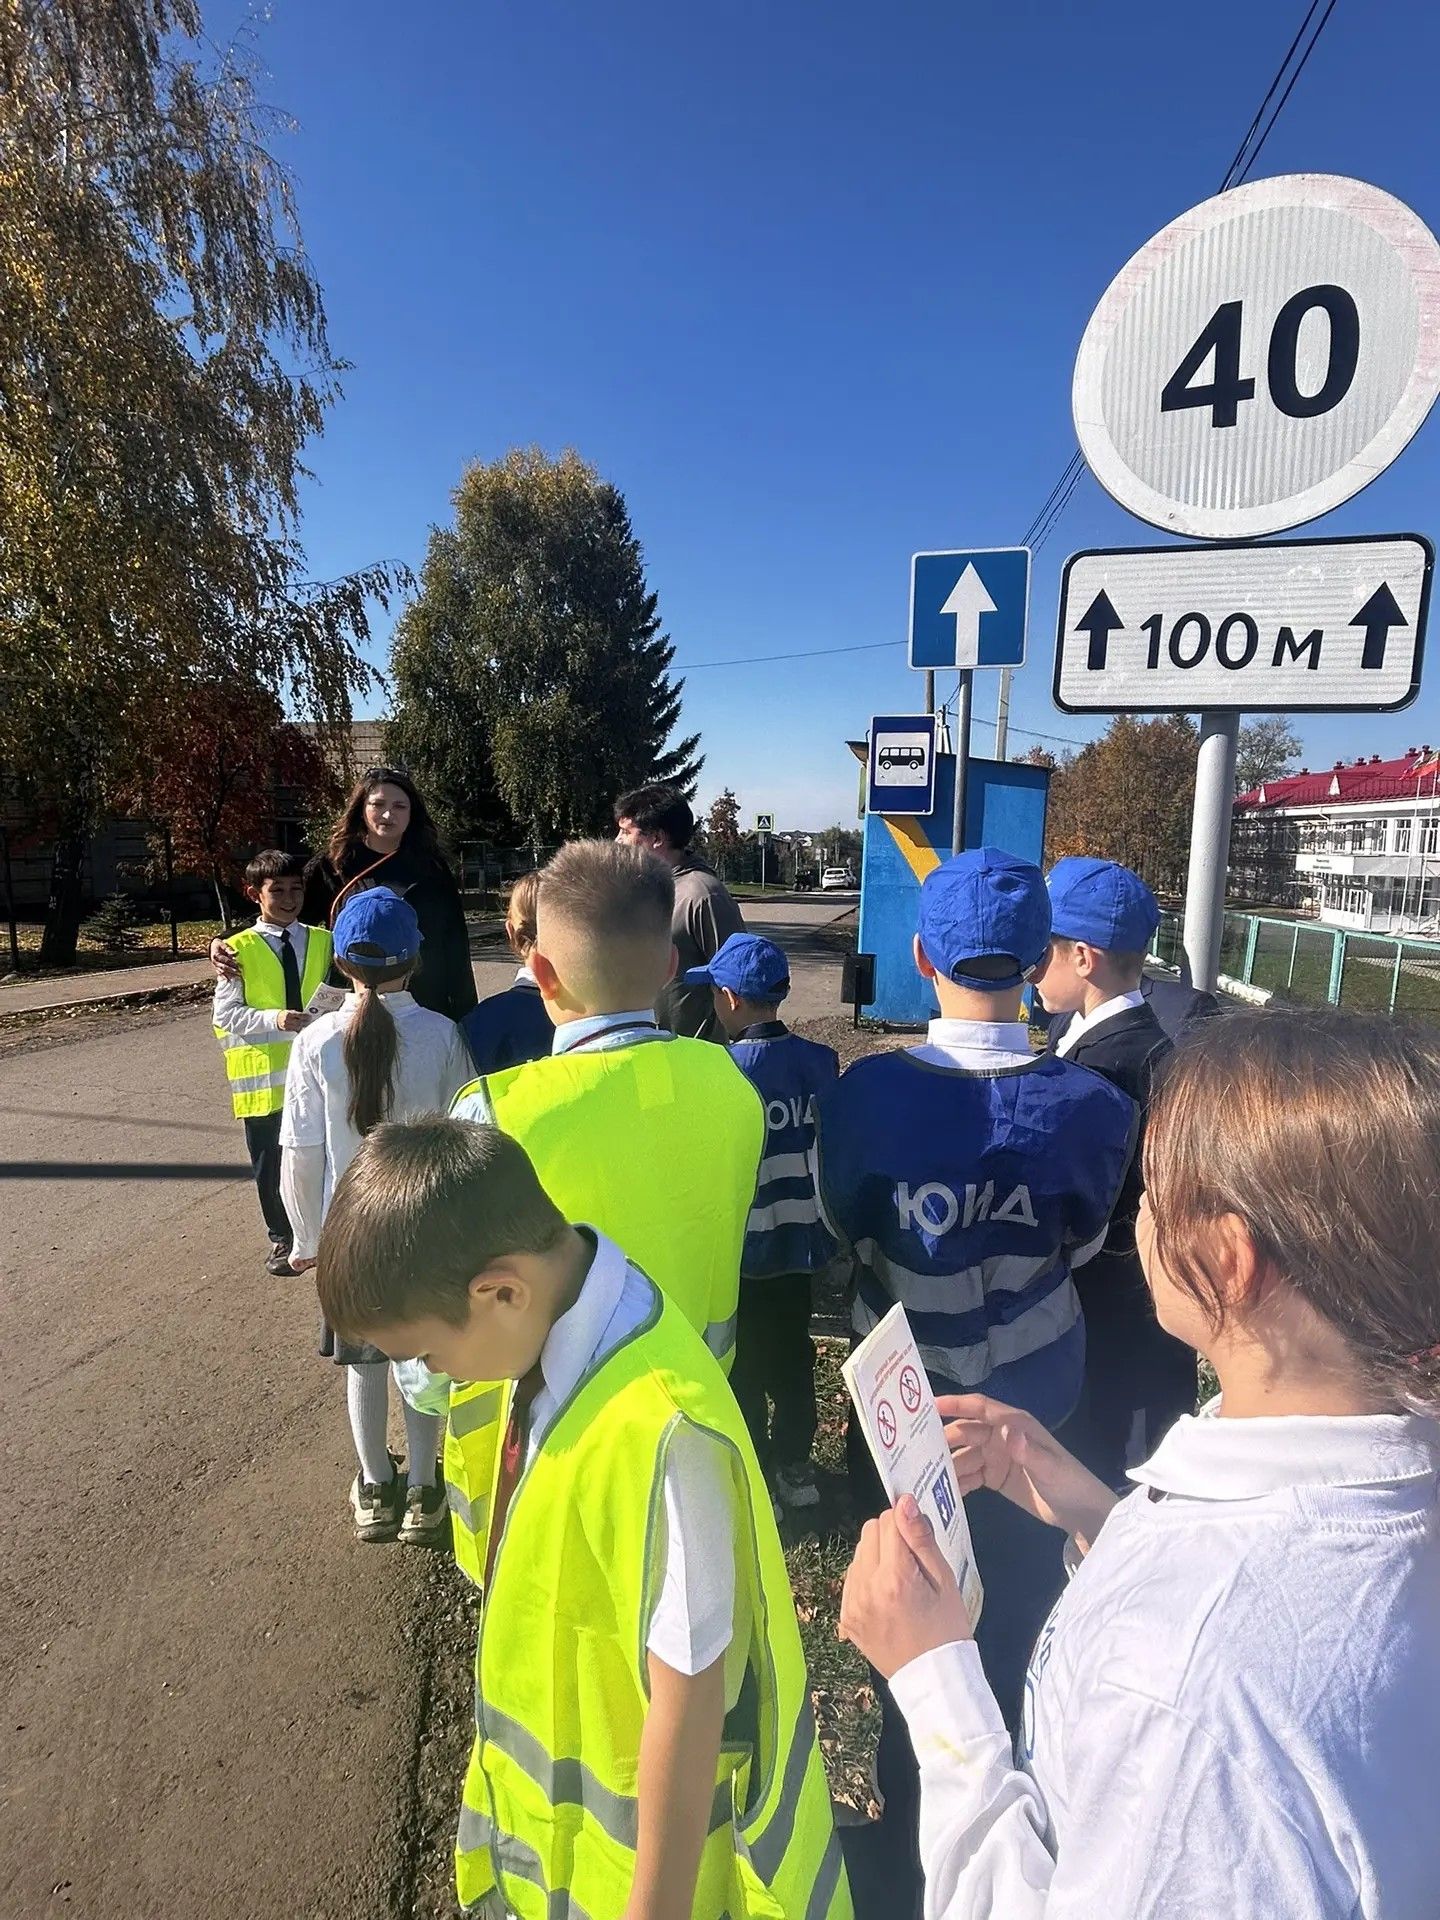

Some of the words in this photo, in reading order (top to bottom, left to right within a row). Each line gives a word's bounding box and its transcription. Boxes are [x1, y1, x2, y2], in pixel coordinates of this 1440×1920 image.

[1161, 284, 1360, 427] 40
[1139, 611, 1259, 671] 100
[897, 1179, 1040, 1236] ЮИД
